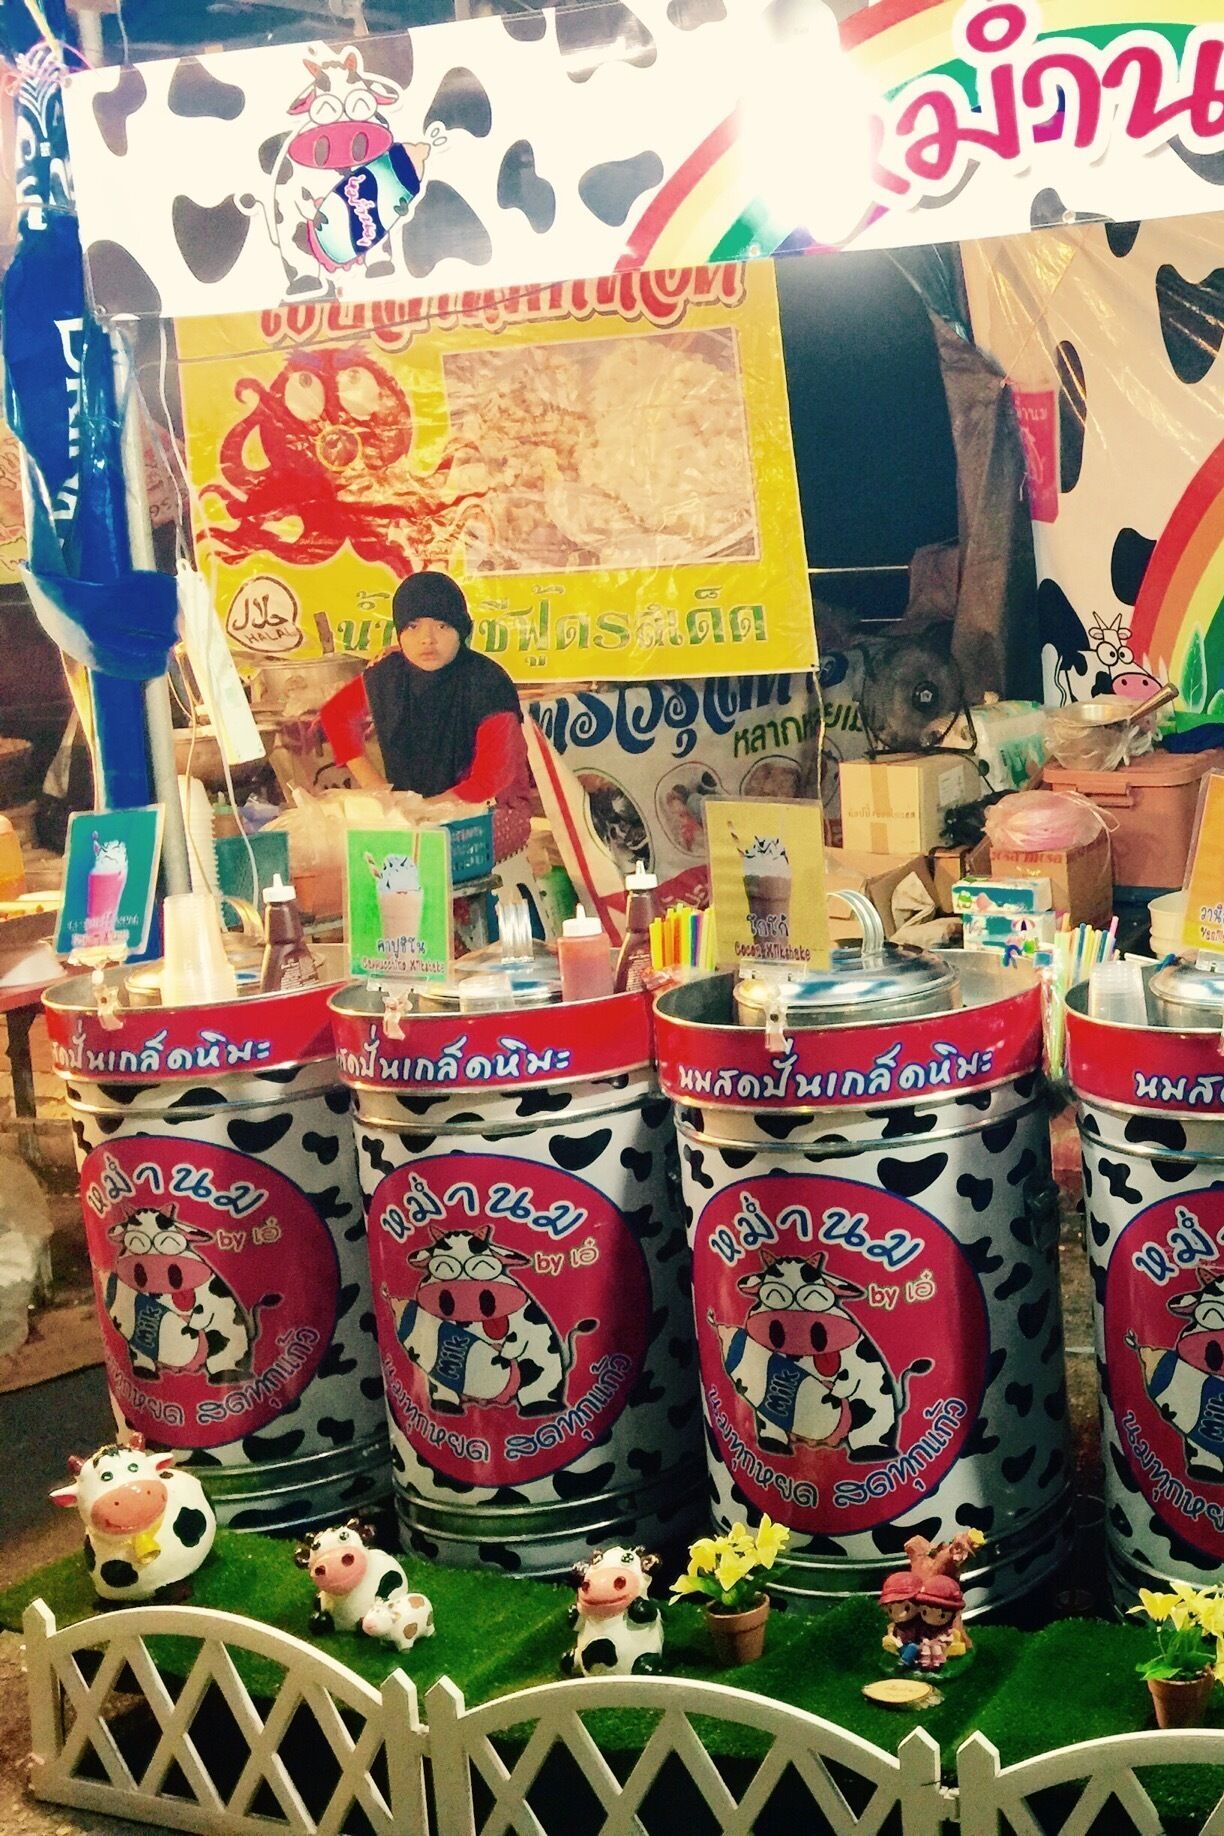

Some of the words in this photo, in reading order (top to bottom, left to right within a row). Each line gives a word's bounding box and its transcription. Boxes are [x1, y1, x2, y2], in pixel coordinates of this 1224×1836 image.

[233, 594, 288, 631] حلال
[246, 625, 298, 643] HALAL
[217, 1229, 245, 1251] by
[534, 1251, 564, 1275] by
[868, 1283, 898, 1309] by
[763, 1363, 800, 1417] Milk
[833, 1398, 968, 1508] สดทุกแก้ว
